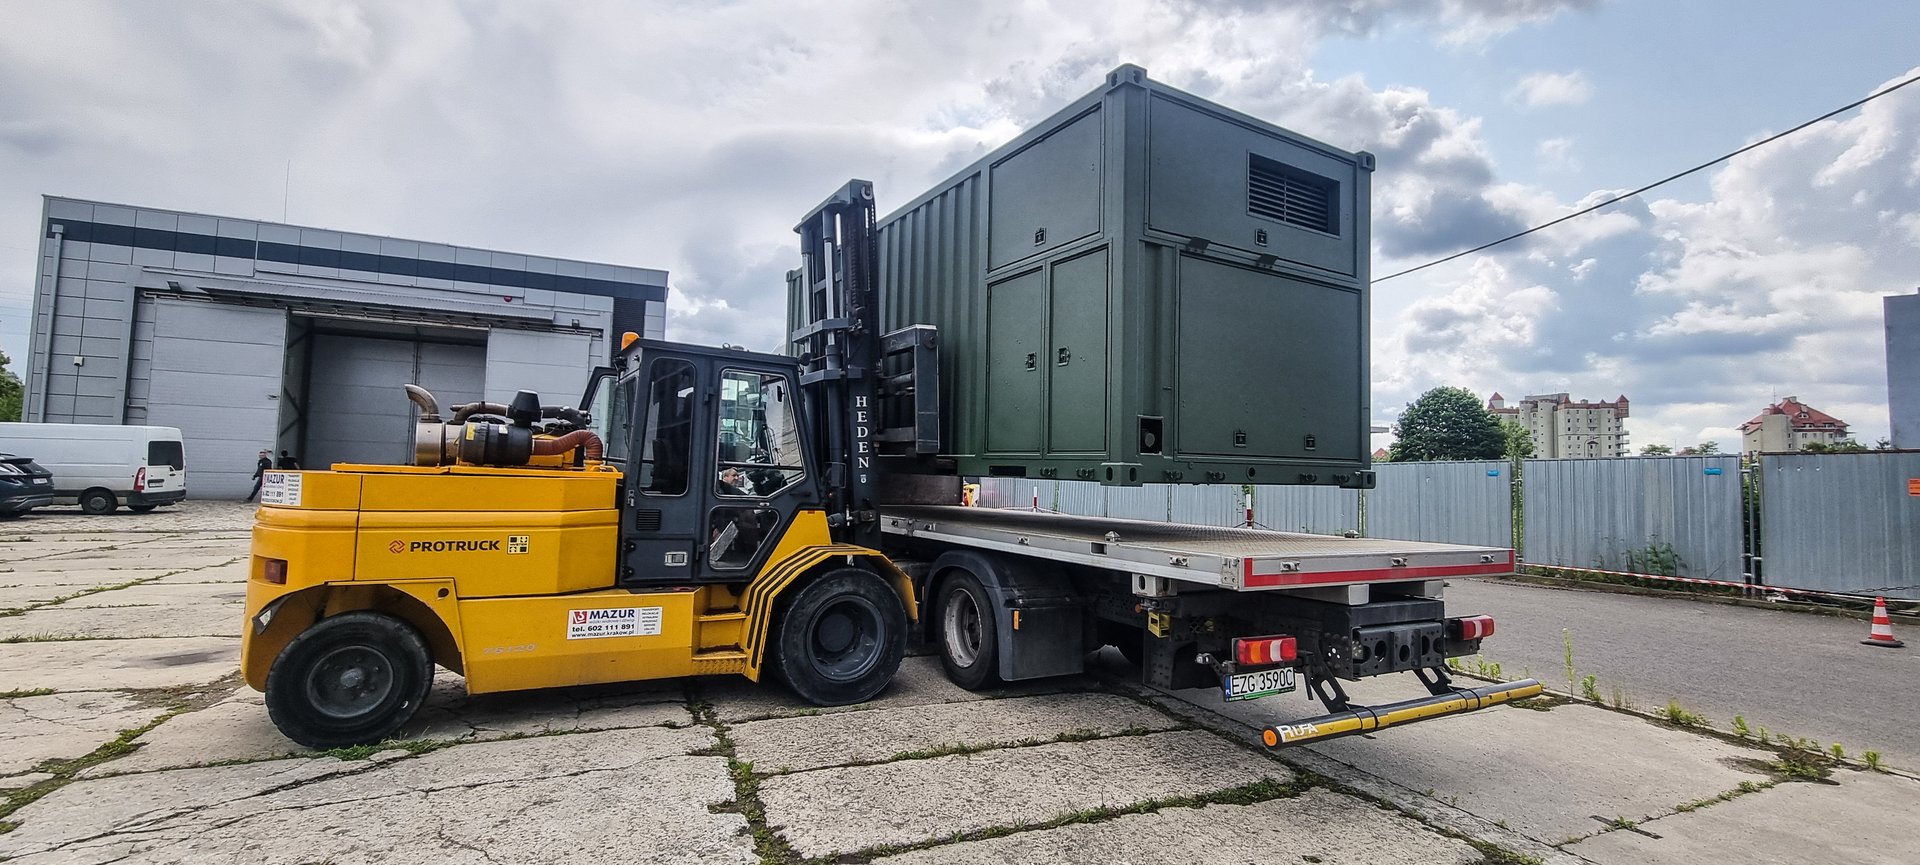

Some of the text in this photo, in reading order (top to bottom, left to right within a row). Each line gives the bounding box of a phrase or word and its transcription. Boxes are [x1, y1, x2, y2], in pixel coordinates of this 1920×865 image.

[855, 395, 869, 469] HEDEN
[410, 540, 500, 552] PROTRUCK
[589, 609, 635, 620] MAZUR
[1231, 675, 1255, 695] EZG
[1259, 669, 1293, 690] 3590C
